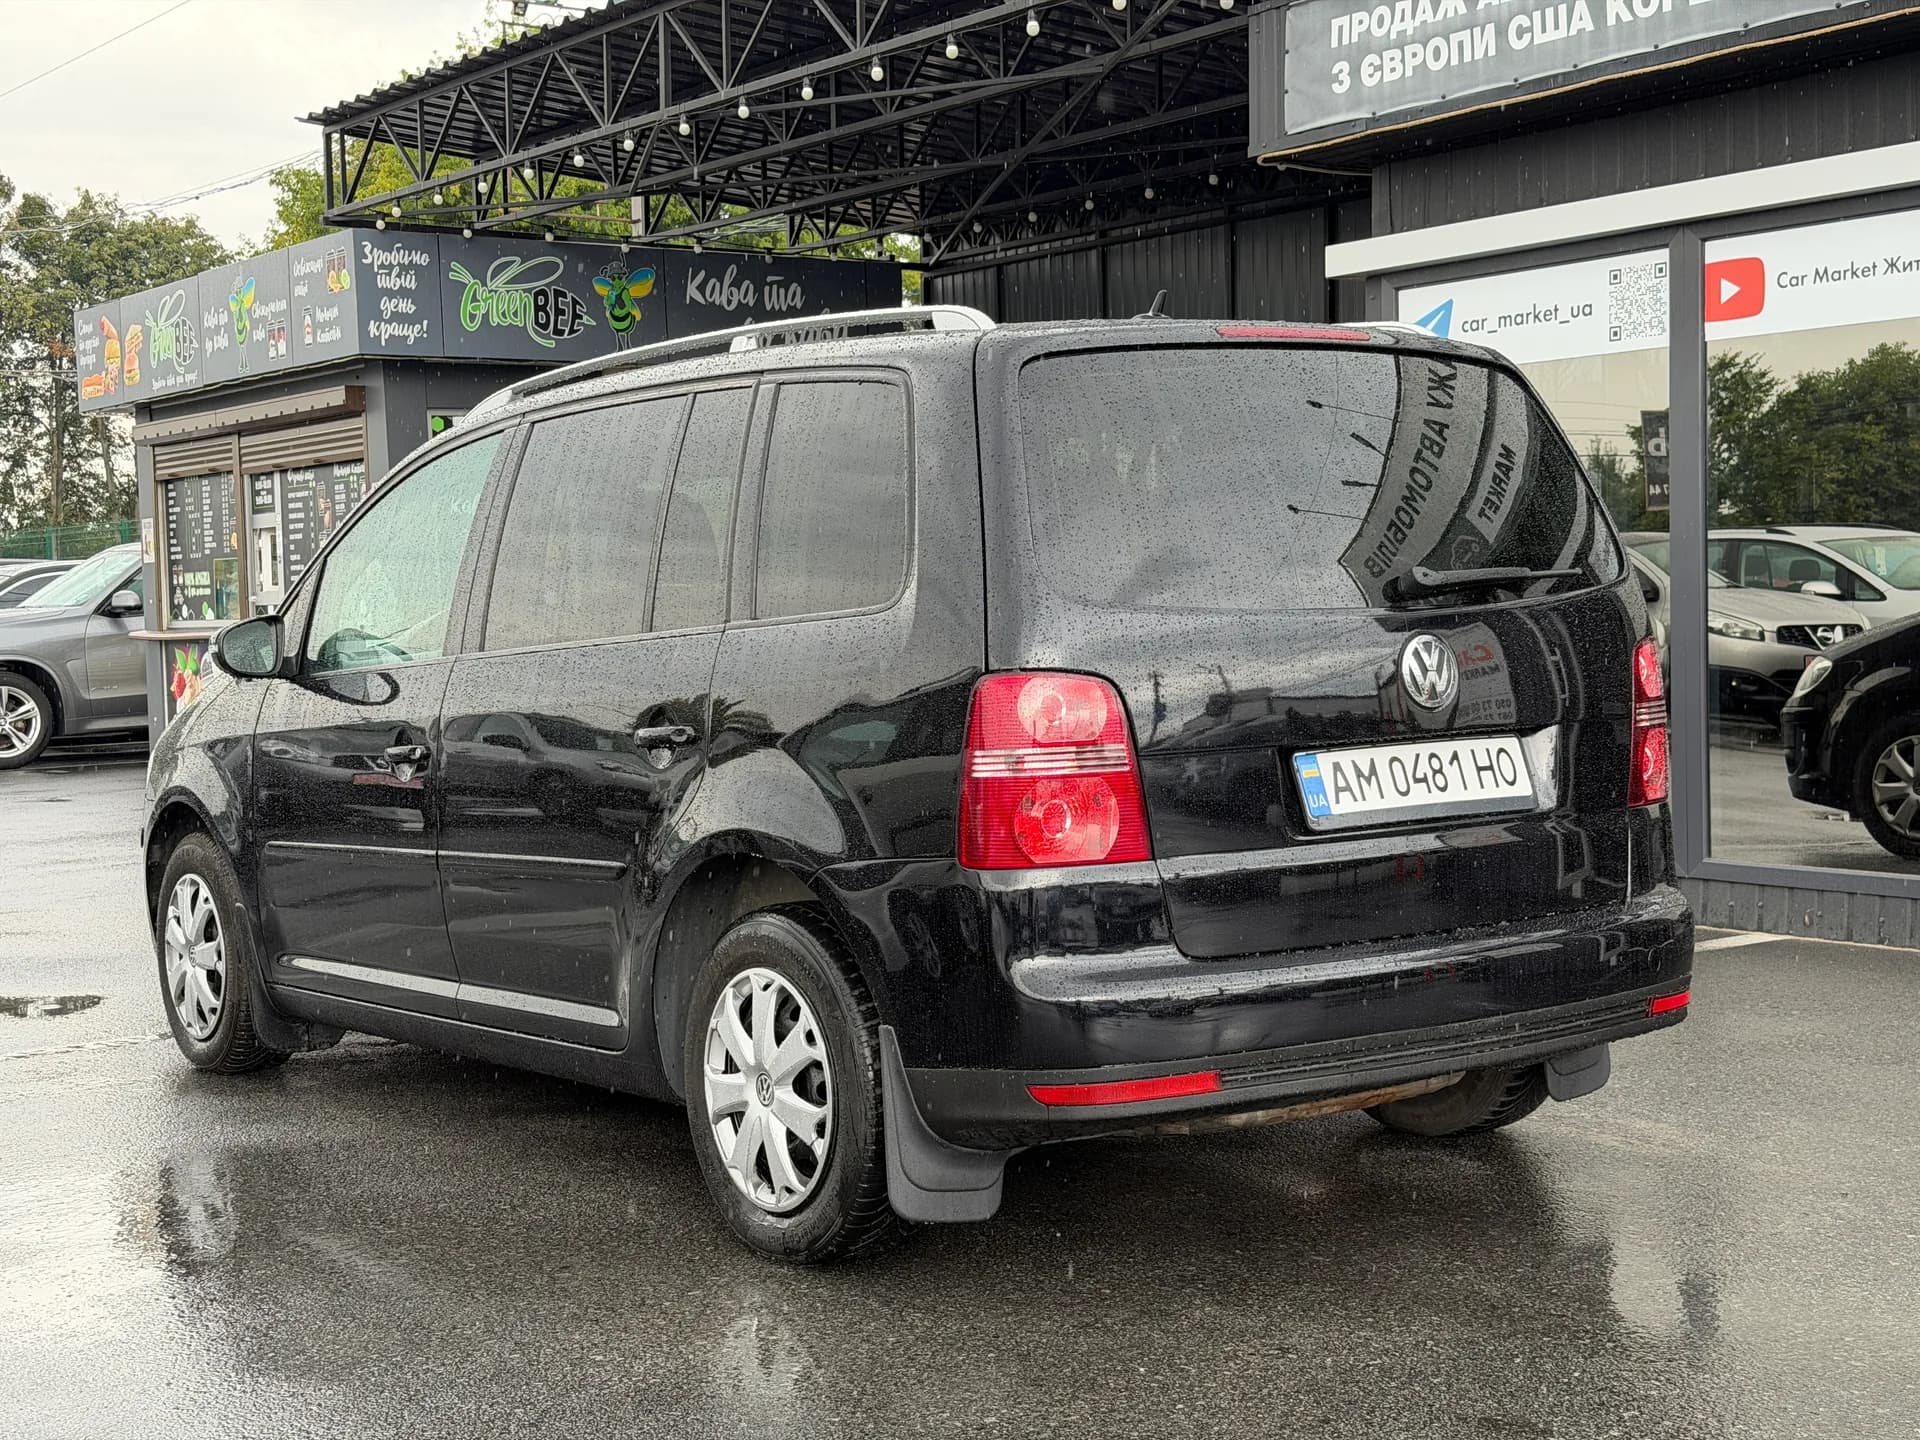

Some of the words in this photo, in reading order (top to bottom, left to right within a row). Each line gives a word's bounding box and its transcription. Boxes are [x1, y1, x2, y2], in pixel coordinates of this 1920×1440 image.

[1330, 0, 1468, 49] ПРОДАЖ
[1360, 23, 1496, 88] ЄВРОПИ
[1507, 0, 1595, 50] США
[361, 241, 431, 272] Зробимо
[376, 266, 418, 290] твій
[686, 264, 759, 311] Кава
[764, 275, 805, 312] та
[1776, 272, 1808, 289] Car
[1813, 261, 1878, 285] Market
[380, 296, 416, 319] день
[1461, 303, 1593, 334] car_market_ua
[368, 320, 429, 346] краще!
[1332, 758, 1384, 804] AM
[1388, 750, 1468, 797] 0481
[1470, 747, 1517, 789] HO
[1309, 794, 1328, 809] UA
